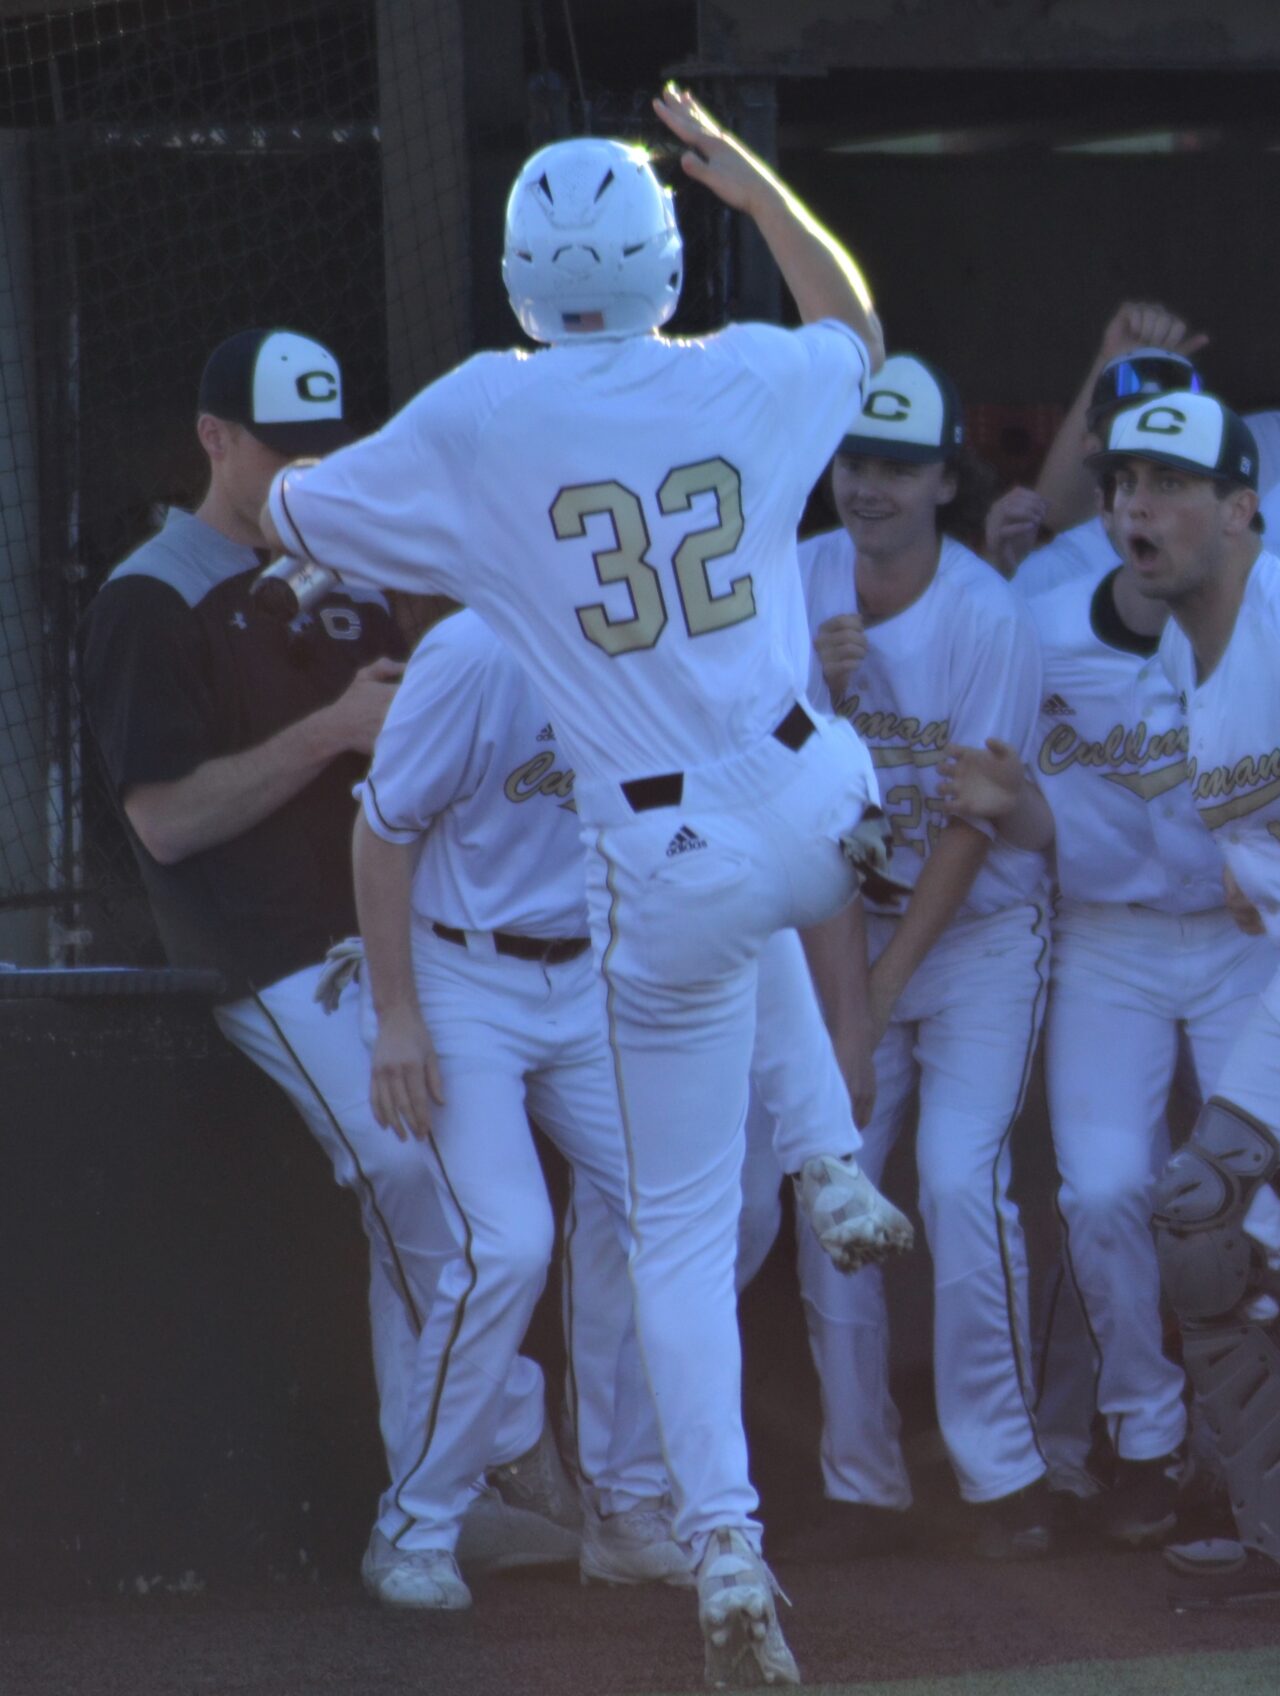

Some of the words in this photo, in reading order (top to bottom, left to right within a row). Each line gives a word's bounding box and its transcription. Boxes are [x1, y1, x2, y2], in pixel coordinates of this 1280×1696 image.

[295, 370, 337, 403] C
[862, 389, 912, 422] C
[1137, 406, 1187, 435] C
[548, 456, 757, 657] 32
[319, 607, 363, 640] C
[1038, 720, 1190, 776] Cullm
